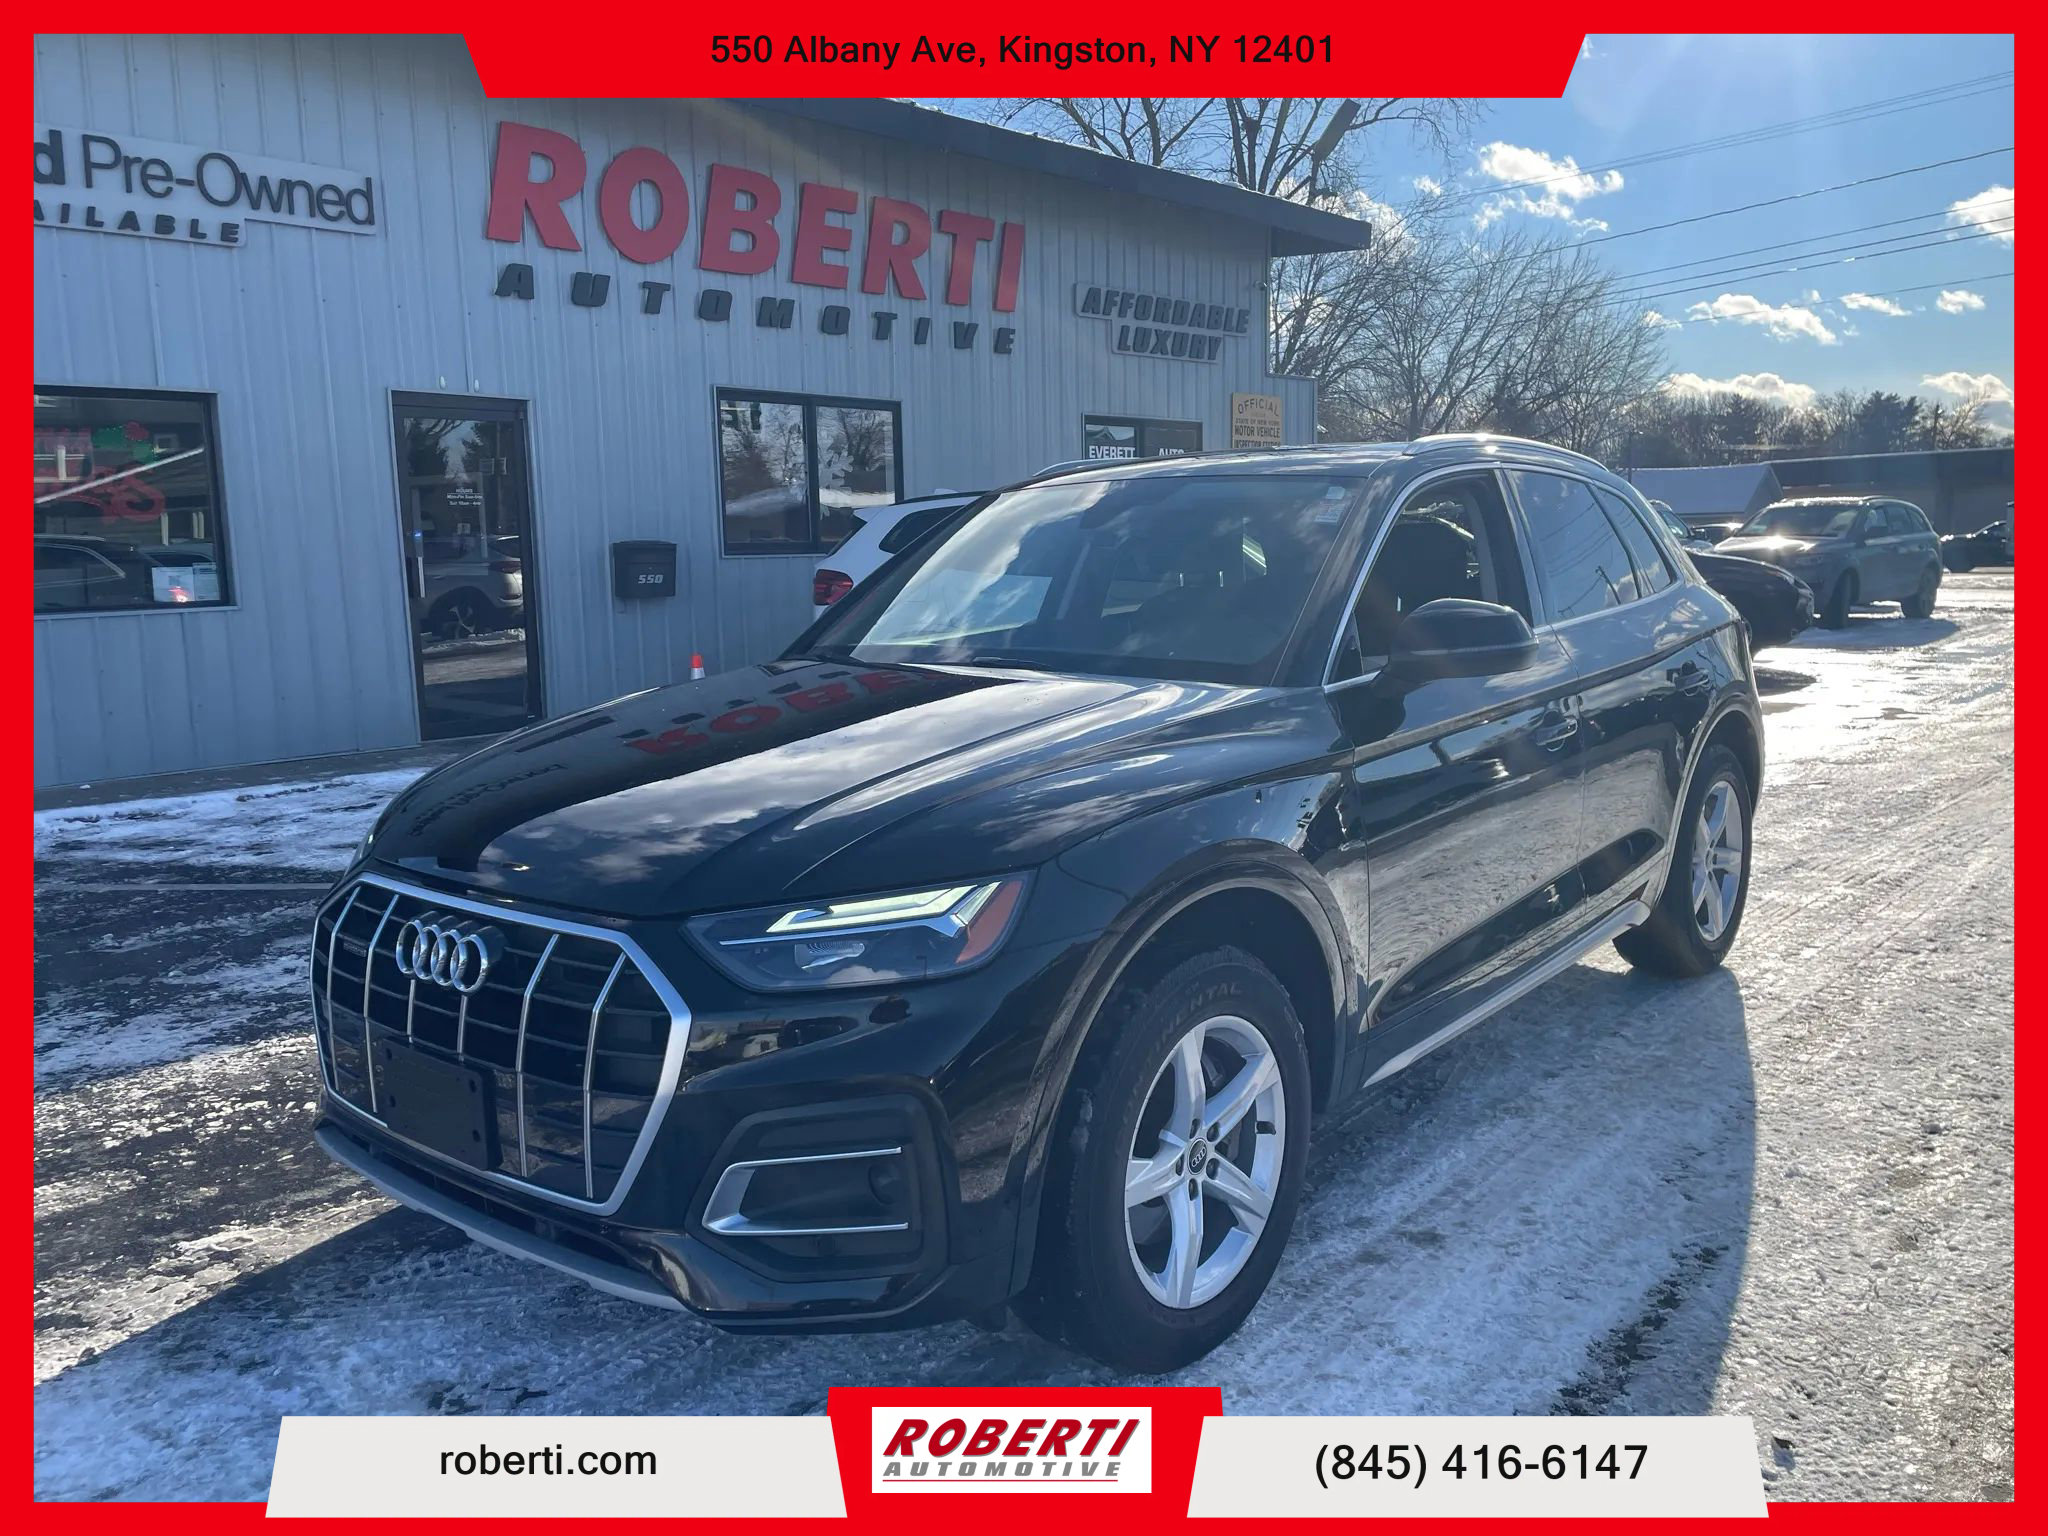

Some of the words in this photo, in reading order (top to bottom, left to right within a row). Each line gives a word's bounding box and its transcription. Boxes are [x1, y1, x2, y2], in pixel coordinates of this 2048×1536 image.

[82, 134, 375, 225] Pre-Owned
[486, 121, 1026, 313] ROBERTI
[495, 263, 1017, 354] AUTOMOTIVE
[1081, 287, 1250, 334] AFFORDABLE
[1116, 325, 1222, 361] LUXURY
[1237, 398, 1280, 417] OFFICIAL
[1234, 425, 1255, 437] MOTOR
[1256, 426, 1281, 438] VEHICLE
[1089, 445, 1135, 459] EVERETT
[638, 574, 664, 584] 550
